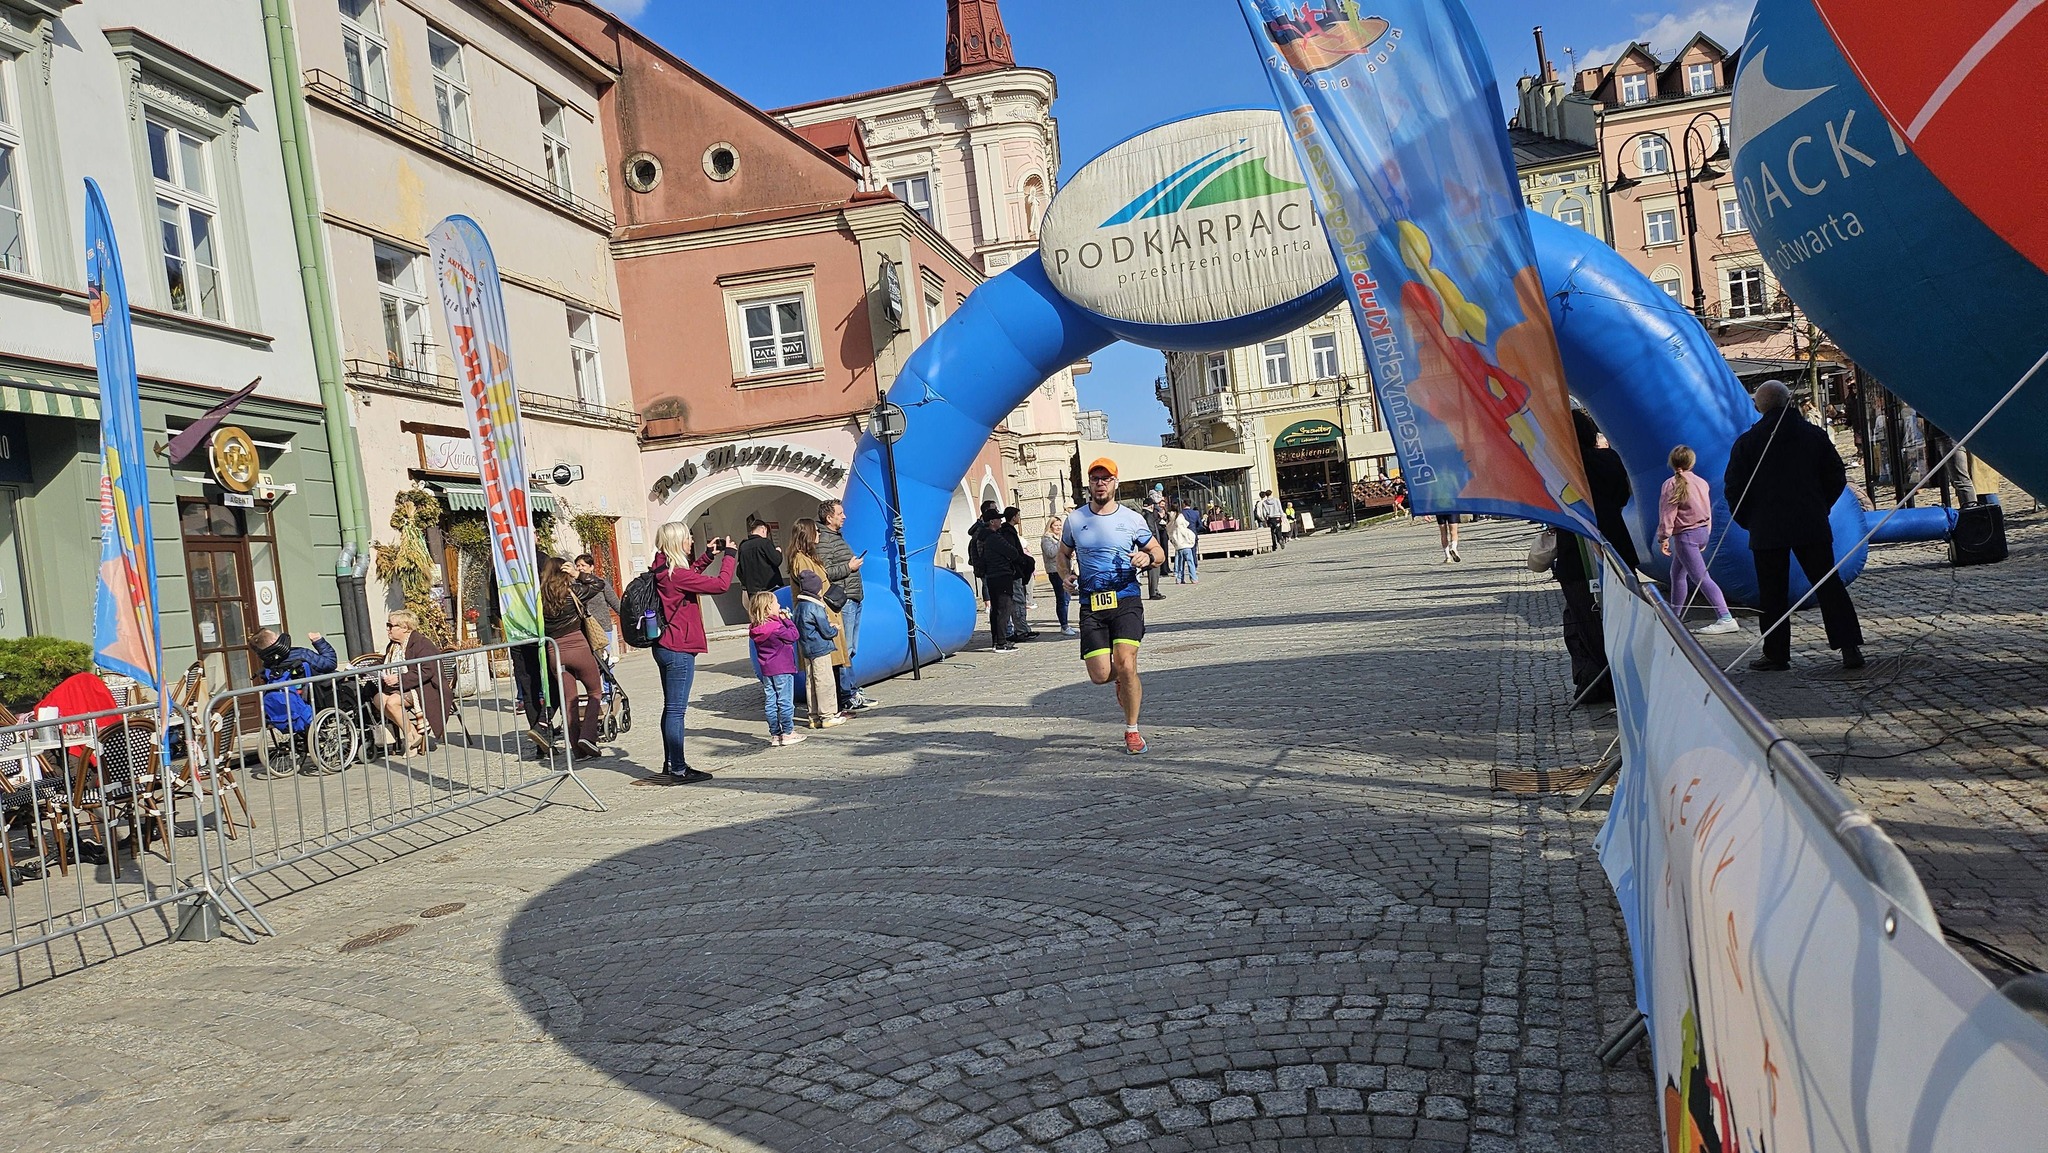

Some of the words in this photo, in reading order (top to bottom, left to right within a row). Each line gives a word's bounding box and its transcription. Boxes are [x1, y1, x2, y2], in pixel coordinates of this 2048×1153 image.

[1776, 211, 1865, 270] otwarta
[1118, 252, 1222, 288] przestrzeń
[1232, 239, 1312, 264] otwarta
[1291, 448, 1330, 459] cukiernia
[652, 459, 698, 499] Pub
[705, 443, 847, 486] Margherita
[230, 496, 249, 504] AGENT
[1095, 593, 1112, 606] 105
